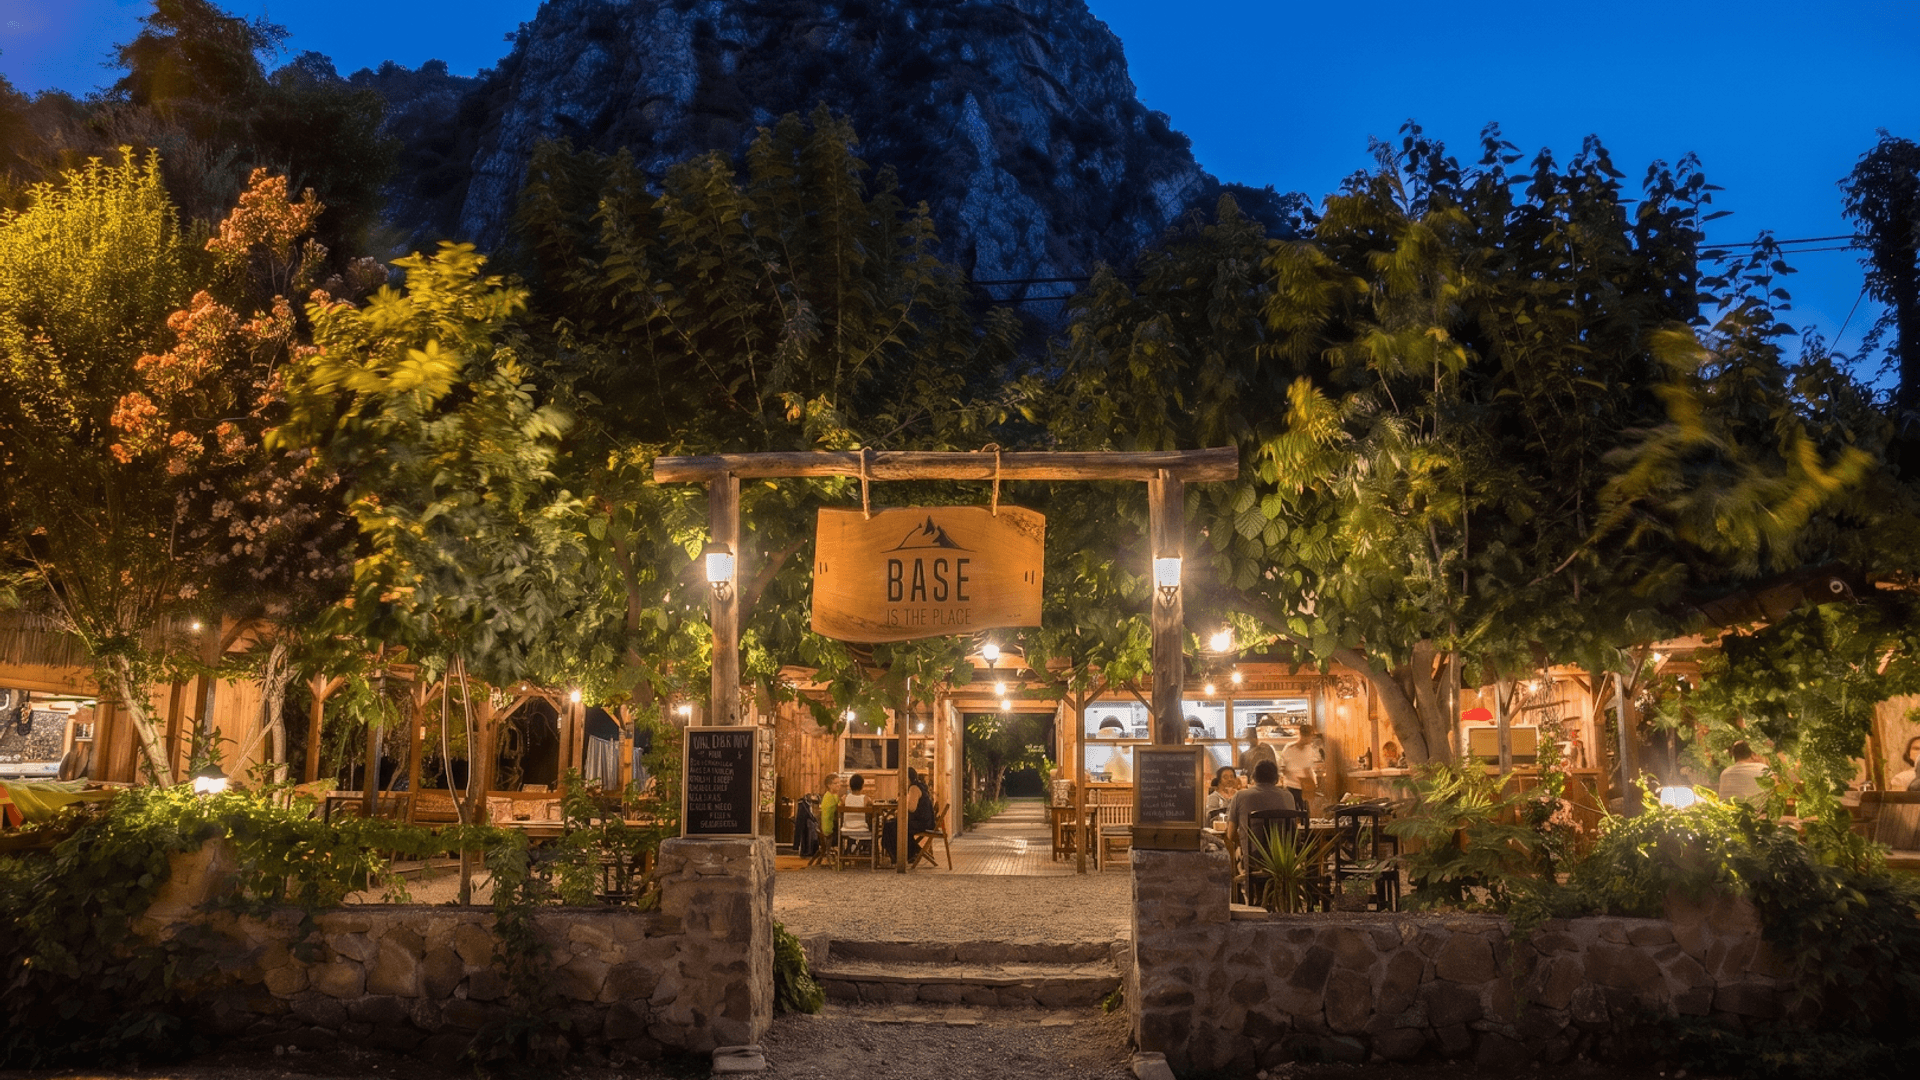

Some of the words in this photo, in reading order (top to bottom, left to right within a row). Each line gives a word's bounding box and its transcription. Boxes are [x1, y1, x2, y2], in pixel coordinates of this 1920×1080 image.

[887, 558, 970, 602] BASE
[885, 608, 899, 626] IS
[904, 608, 927, 625] THE
[933, 608, 971, 625] PLACE
